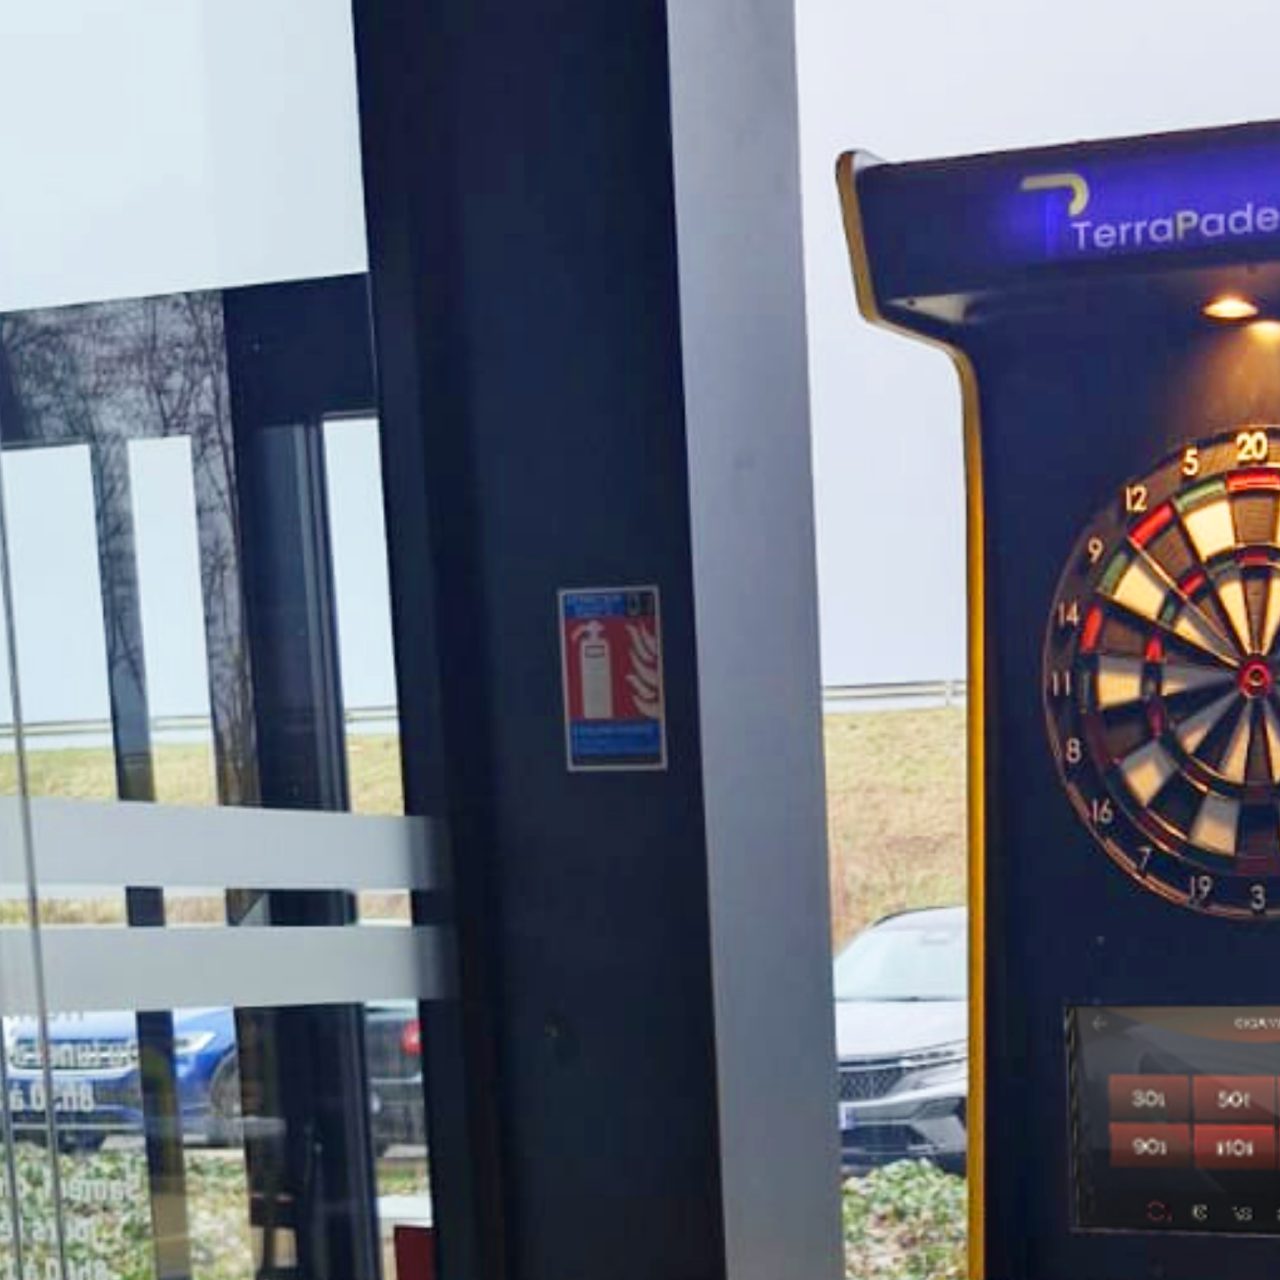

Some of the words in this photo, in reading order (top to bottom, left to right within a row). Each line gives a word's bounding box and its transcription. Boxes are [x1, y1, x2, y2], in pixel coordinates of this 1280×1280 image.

[1236, 431, 1268, 462] 20
[1182, 448, 1199, 476] 5
[1124, 486, 1148, 513] 12
[1087, 538, 1103, 564] 9
[1057, 603, 1080, 626] 14
[1051, 671, 1071, 697] 11
[1065, 737, 1081, 765] 8
[1090, 798, 1113, 824] 16
[1137, 847, 1153, 871] 7
[1188, 874, 1212, 899] 19
[1249, 884, 1266, 911] 3
[1132, 1090, 1166, 1108] 301
[1132, 1137, 1167, 1156] 901
